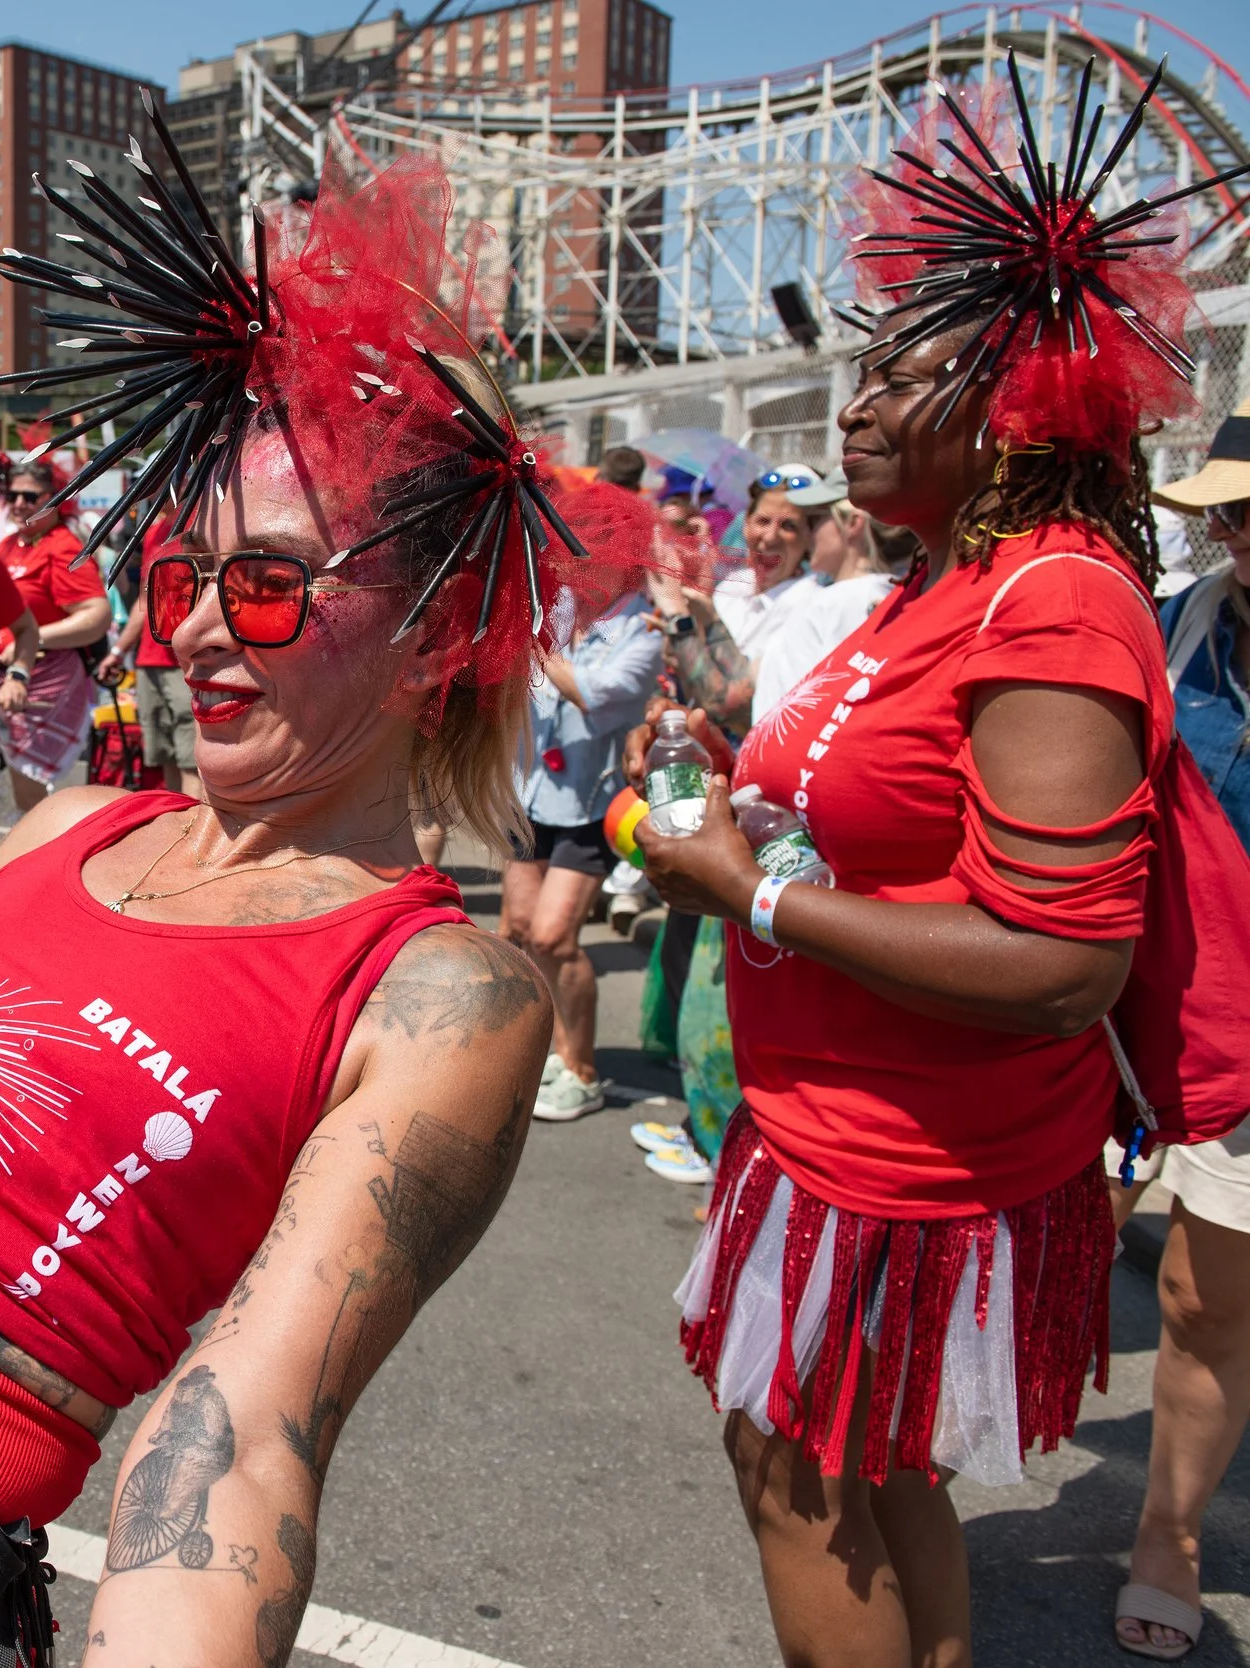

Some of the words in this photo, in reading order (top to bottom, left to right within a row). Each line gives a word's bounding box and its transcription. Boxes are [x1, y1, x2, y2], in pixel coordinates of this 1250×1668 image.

[806, 702, 853, 762] NEW
[78, 997, 223, 1124] BATALÁ
[65, 1152, 150, 1233] NEW
